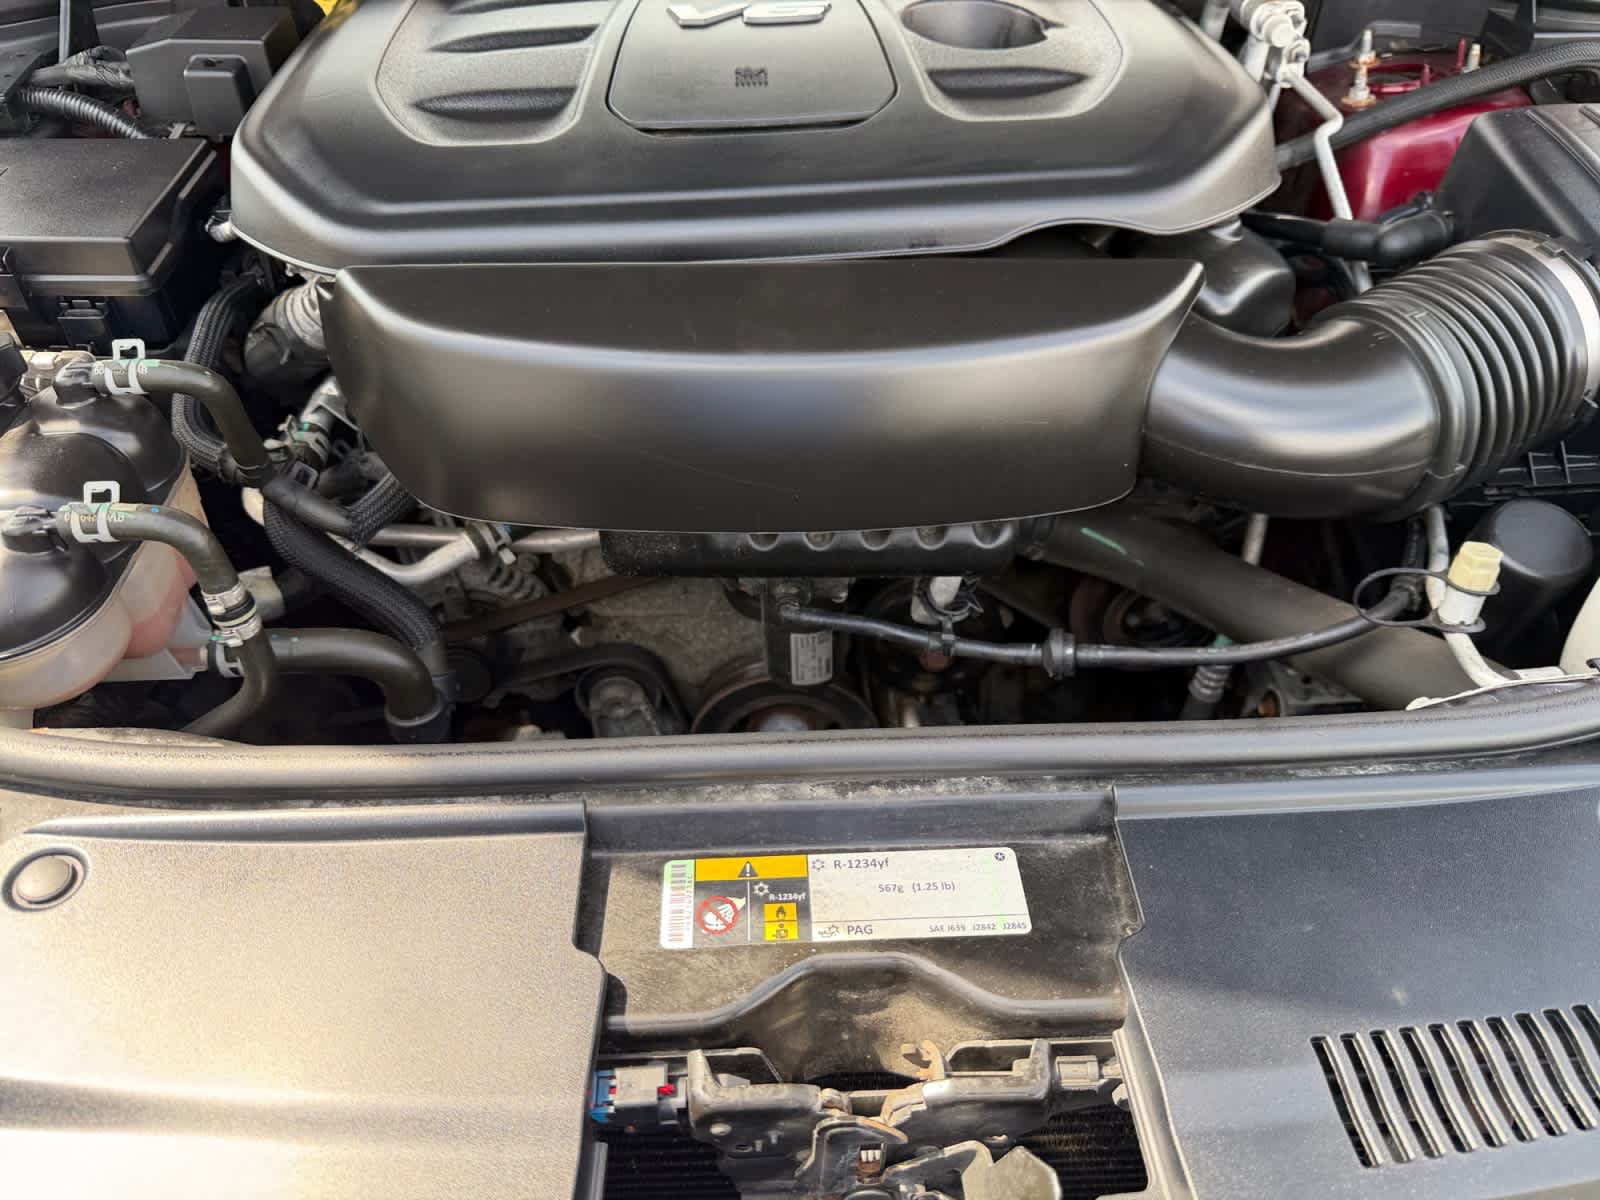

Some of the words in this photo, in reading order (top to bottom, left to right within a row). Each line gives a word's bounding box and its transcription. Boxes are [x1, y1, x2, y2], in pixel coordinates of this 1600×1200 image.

[833, 858, 889, 872] R-1234yf
[878, 883, 904, 893] 567g
[912, 881, 937, 892] (1.25
[941, 881, 956, 892] lb)
[846, 924, 873, 935] PAG
[929, 924, 944, 933] SAE
